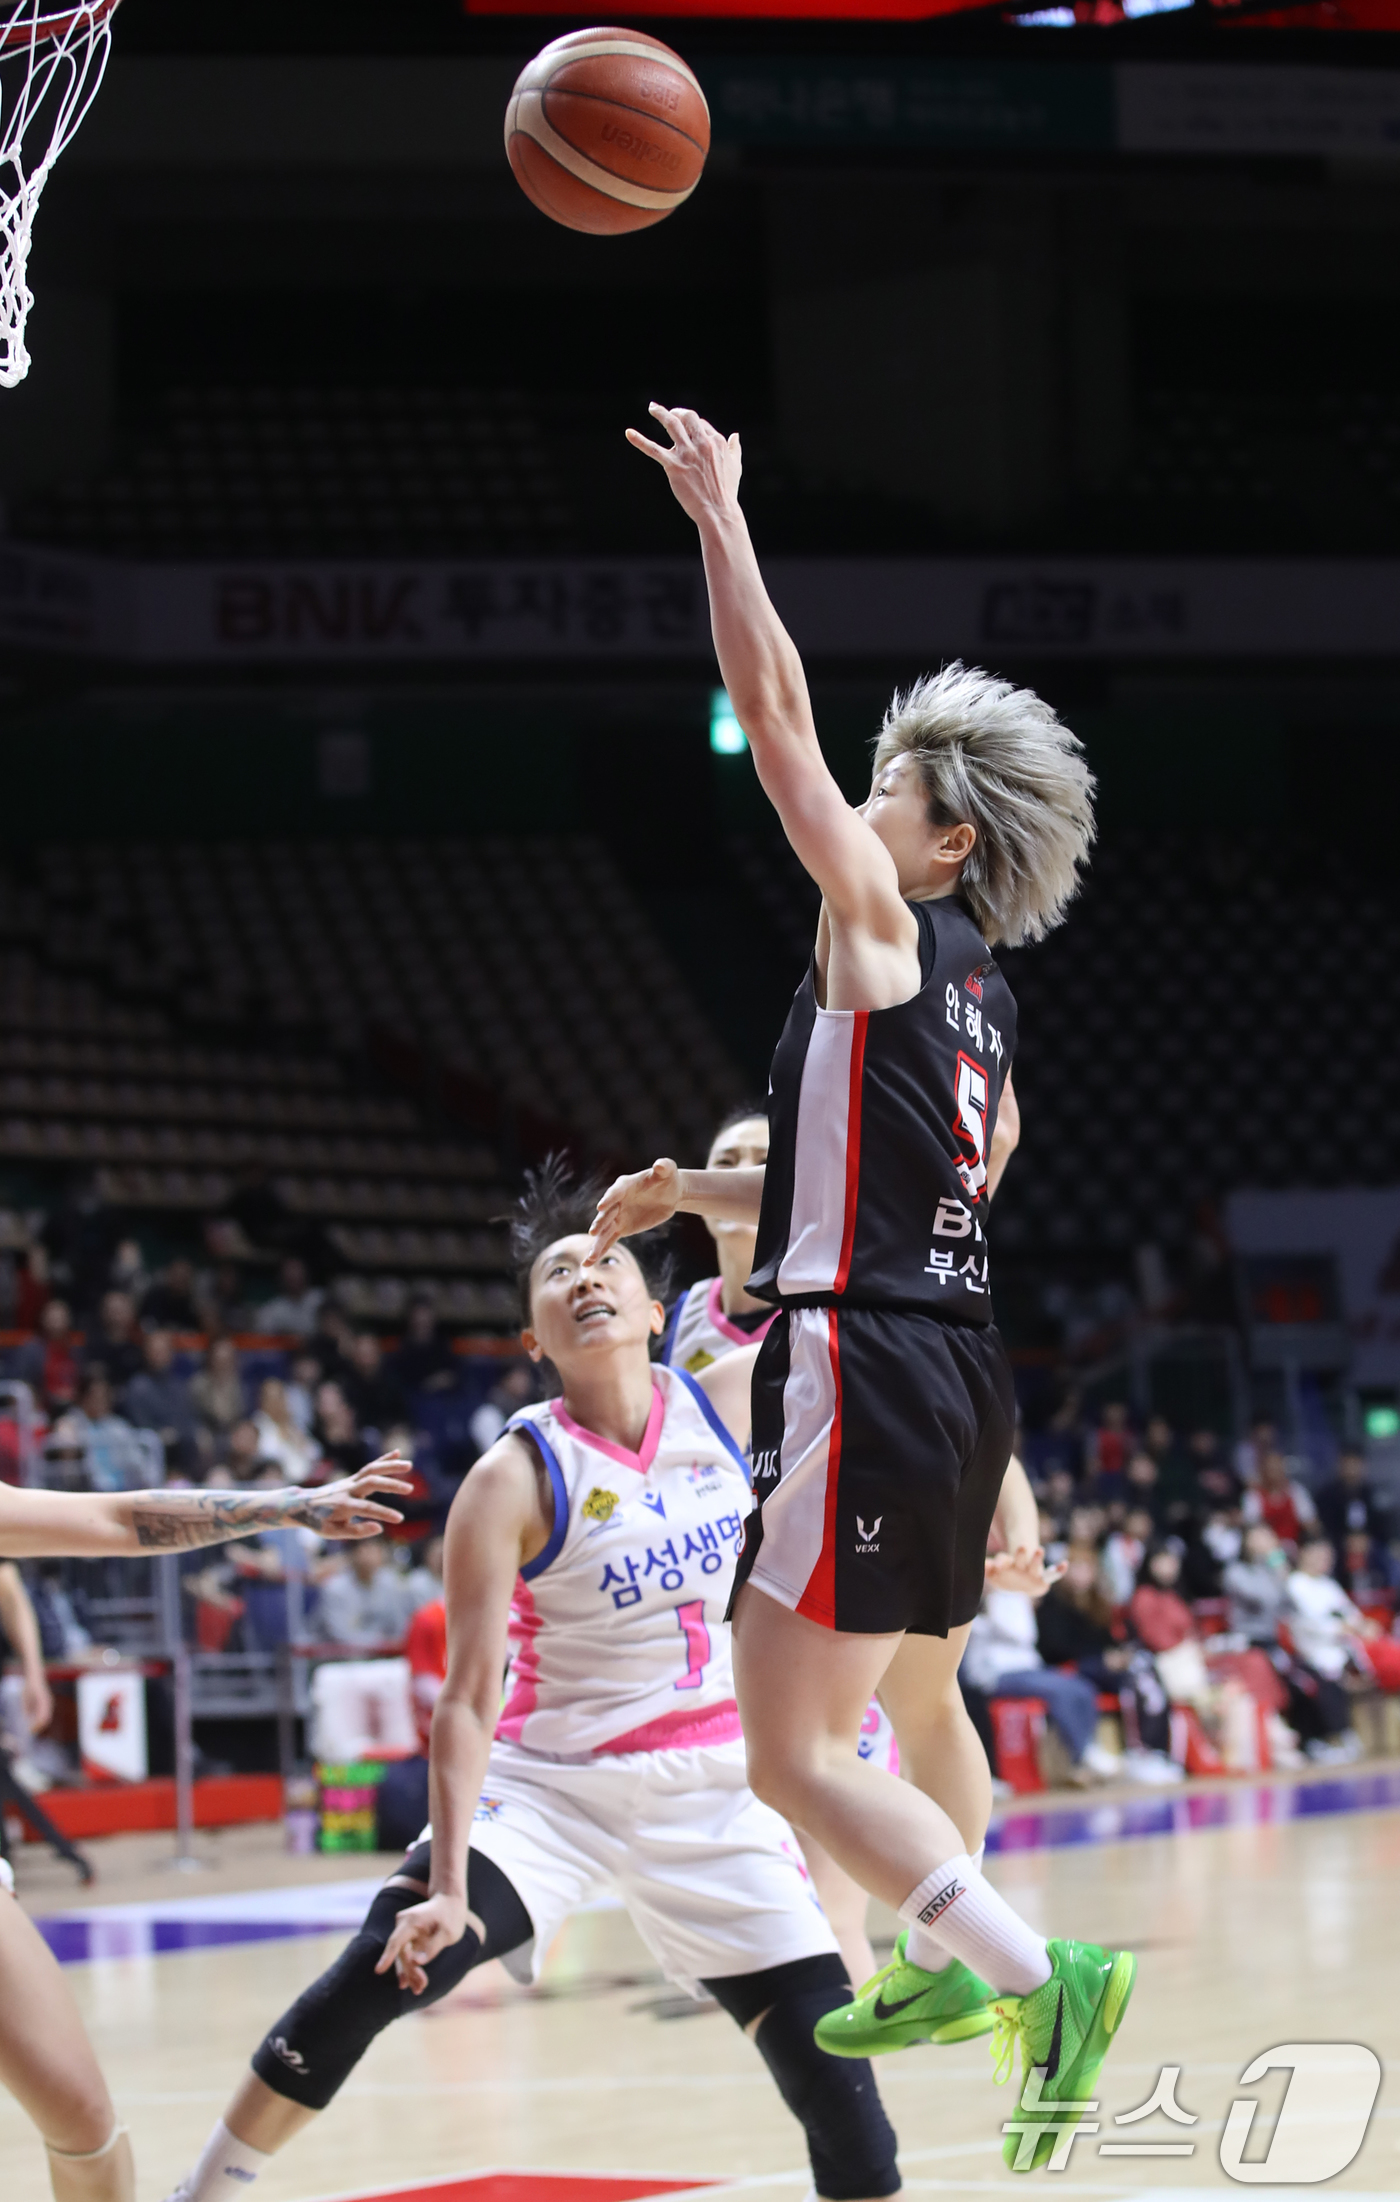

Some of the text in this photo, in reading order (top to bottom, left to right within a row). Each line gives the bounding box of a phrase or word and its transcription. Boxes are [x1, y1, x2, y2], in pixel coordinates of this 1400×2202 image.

[600, 121, 684, 173] molten
[214, 577, 423, 642] BNK
[953, 1050, 989, 1204] 5
[924, 1248, 991, 1296] 부산
[855, 1543, 880, 1553] VEXX
[674, 1599, 711, 1690] 1
[918, 1880, 966, 1926] BNK
